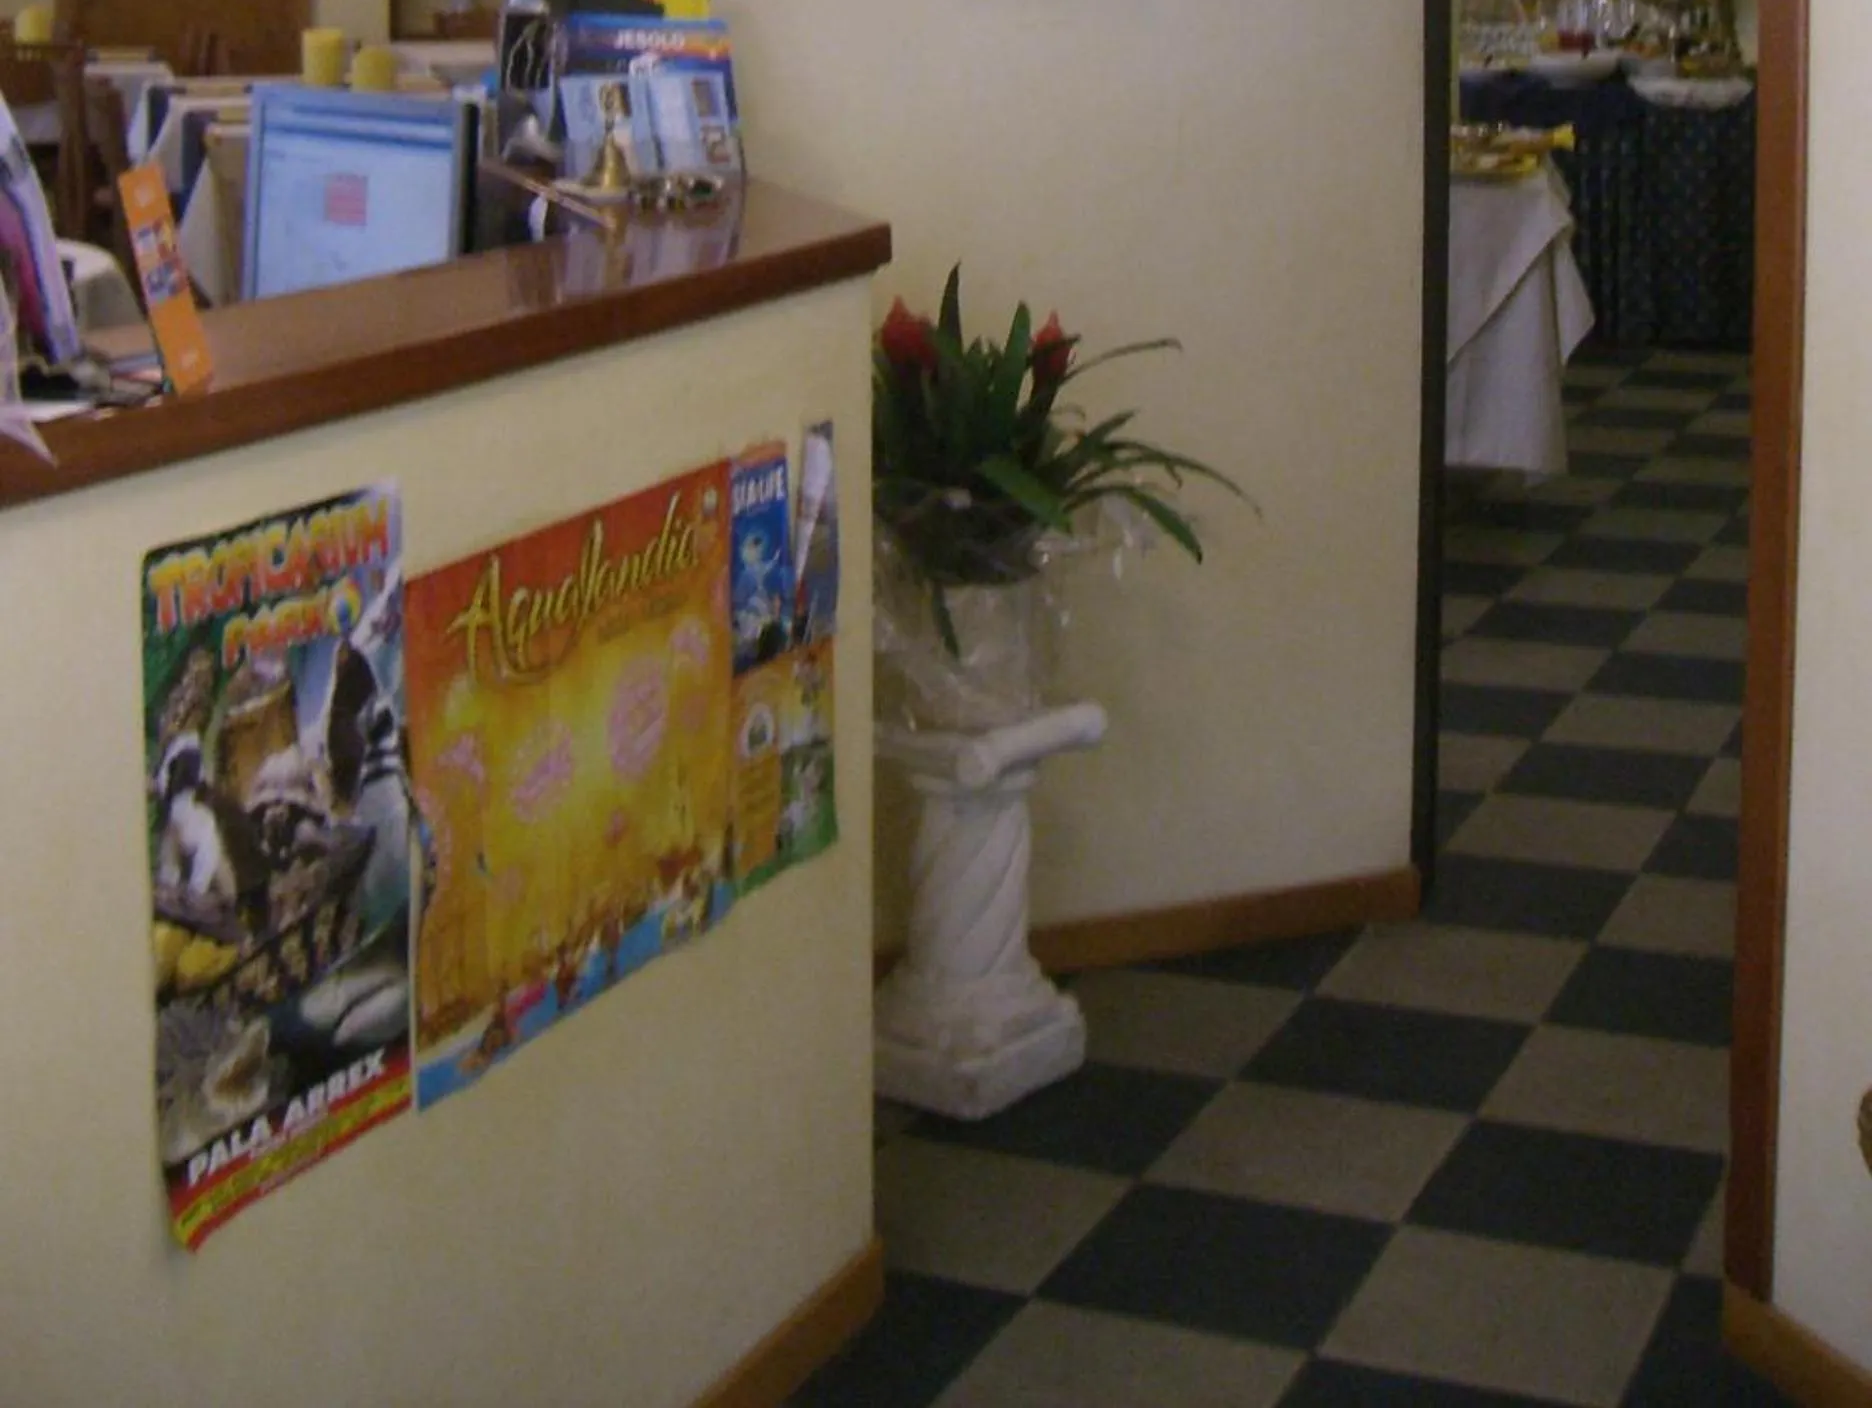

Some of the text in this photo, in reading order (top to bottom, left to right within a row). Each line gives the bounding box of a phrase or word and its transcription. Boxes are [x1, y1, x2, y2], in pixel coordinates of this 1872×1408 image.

[614, 28, 686, 51] JESOLO
[148, 497, 390, 634] TROPICARIUM
[188, 1114, 273, 1188] PALA
[283, 1046, 387, 1134] ARREX
